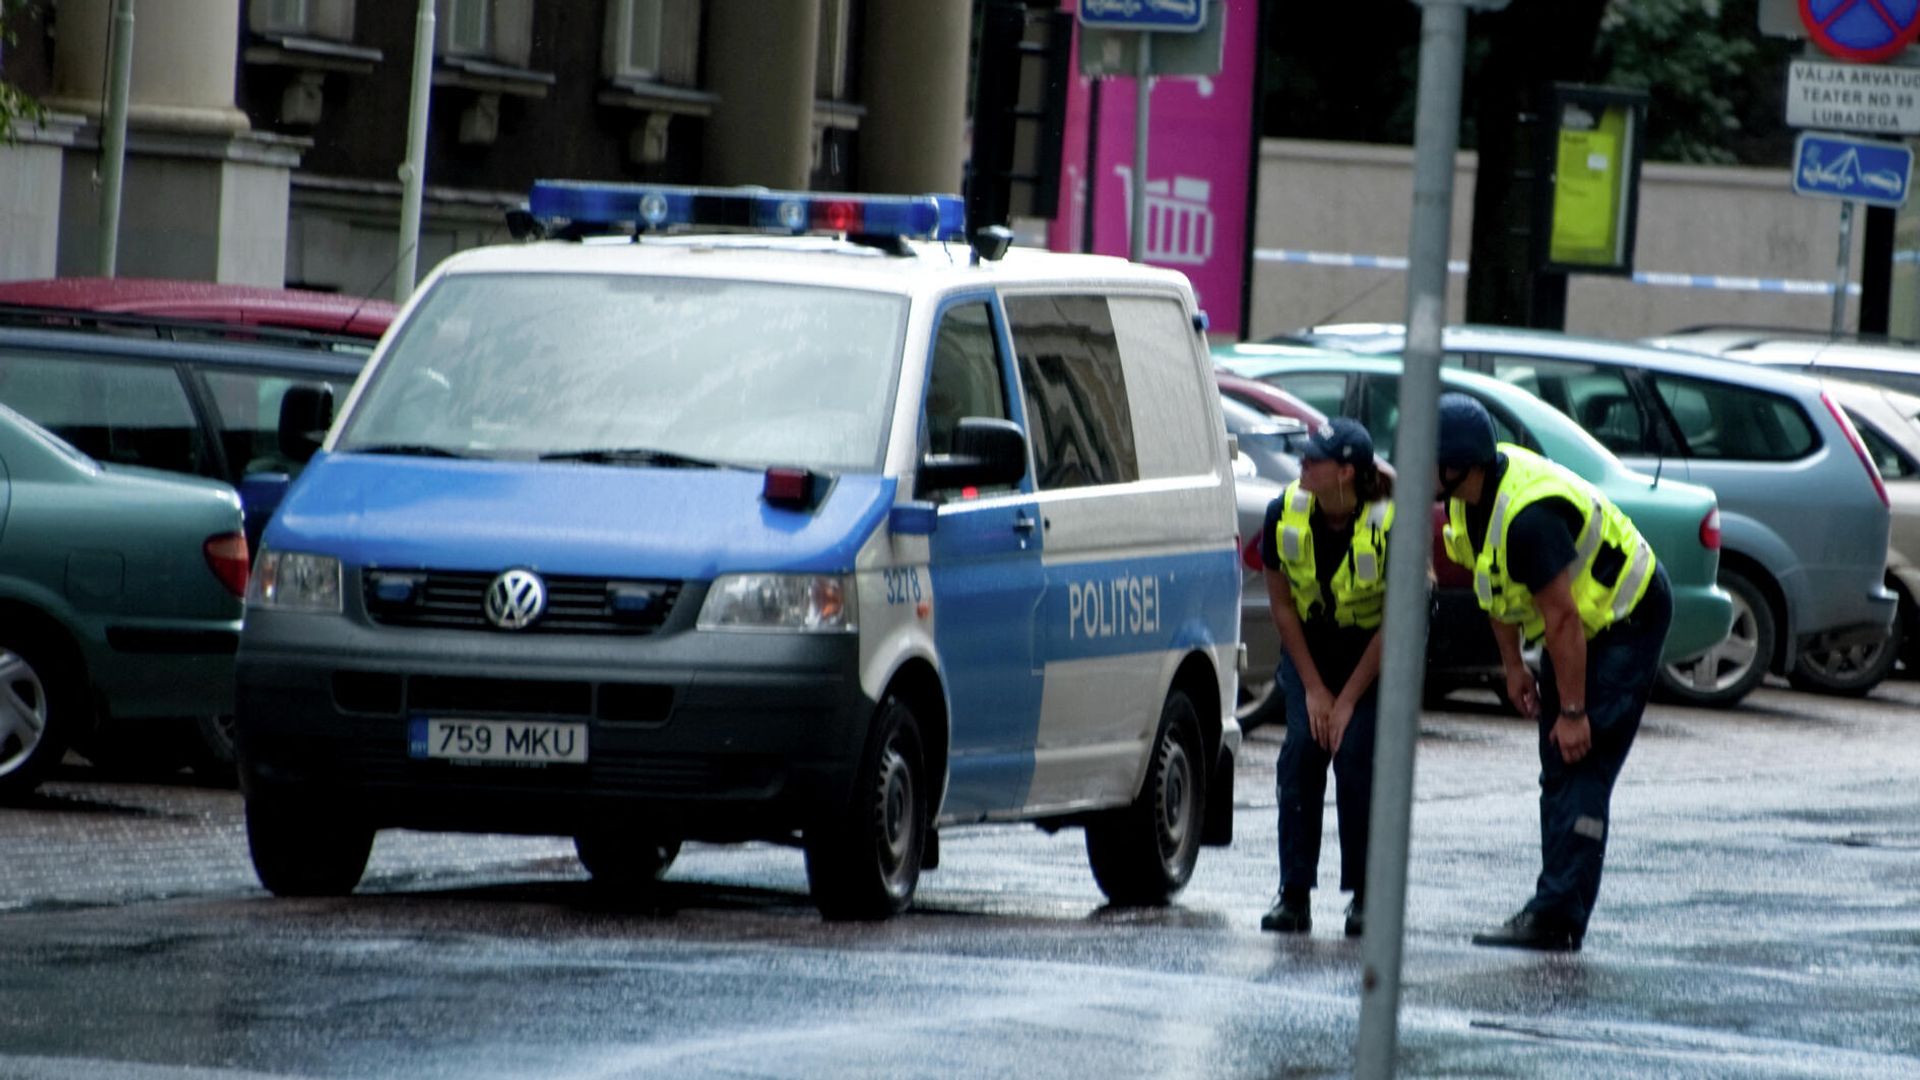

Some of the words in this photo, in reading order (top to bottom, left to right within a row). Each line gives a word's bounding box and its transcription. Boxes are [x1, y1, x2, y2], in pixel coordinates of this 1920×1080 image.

[1803, 86, 1863, 105] TEATER
[1868, 91, 1891, 107] NO
[1812, 108, 1899, 126] LUBADEGA
[884, 567, 922, 605] 3278
[1068, 575, 1160, 640] POLITSEI
[439, 724, 492, 753] 759
[505, 726, 575, 757] MKU
